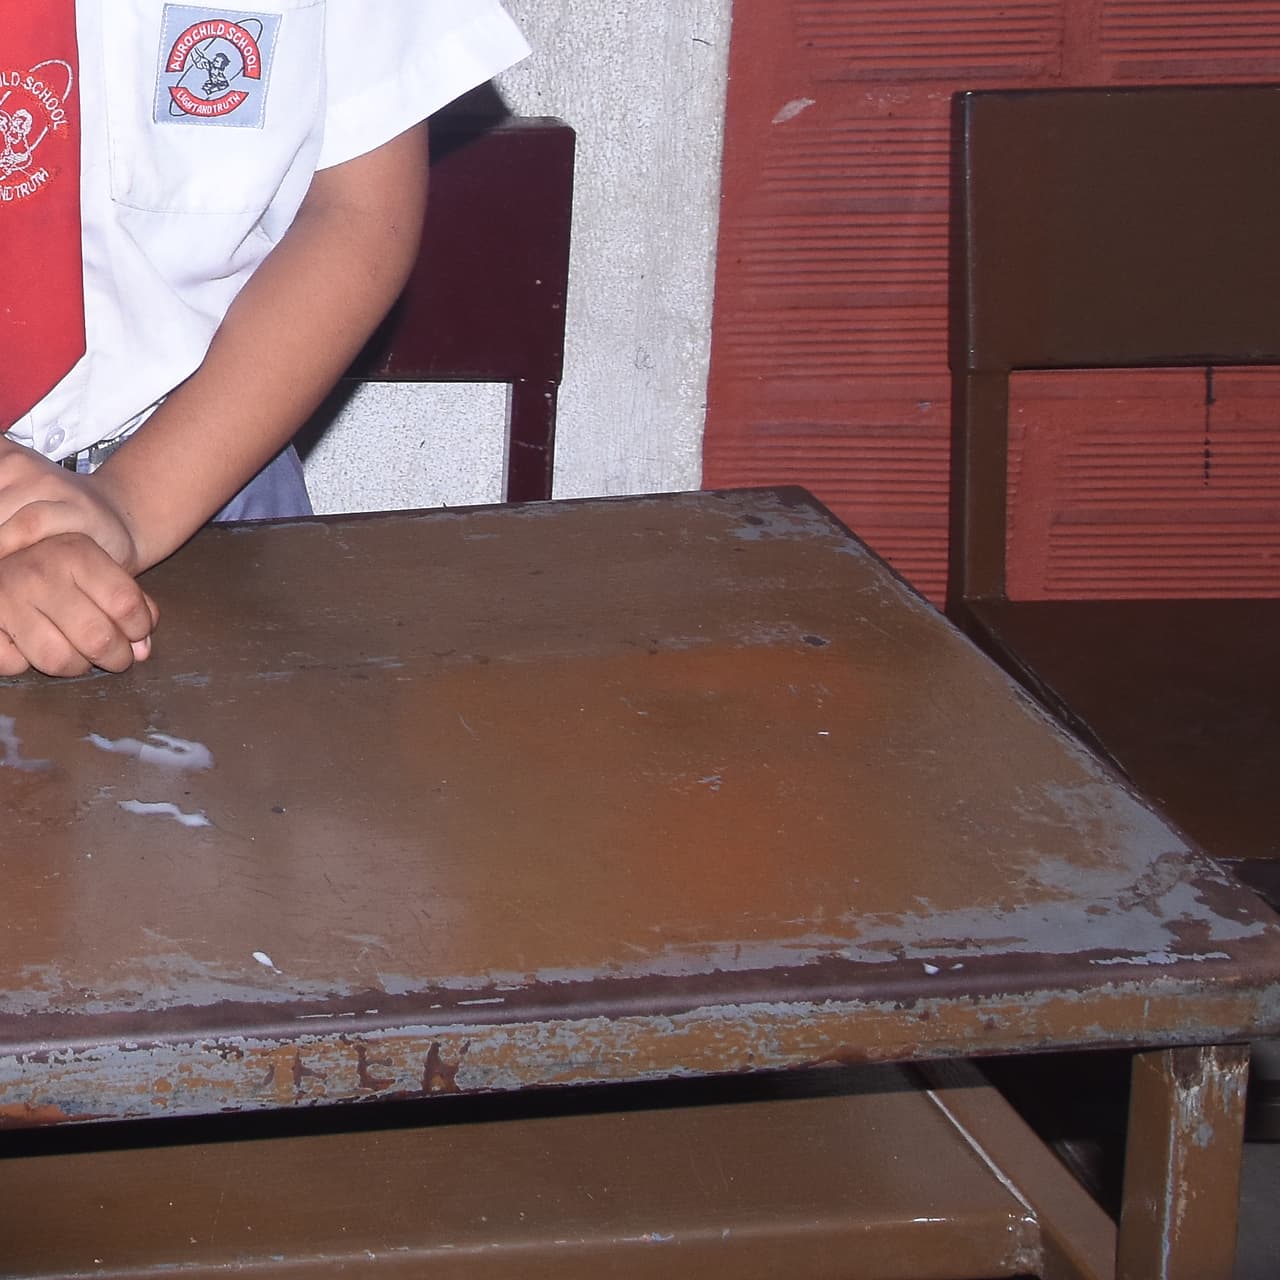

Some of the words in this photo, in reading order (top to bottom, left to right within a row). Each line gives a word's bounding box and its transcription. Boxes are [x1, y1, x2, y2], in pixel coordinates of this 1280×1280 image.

[171, 23, 225, 70] AUROCHILD
[226, 27, 257, 72] SCHOOL
[23, 76, 68, 130] SCHOOL
